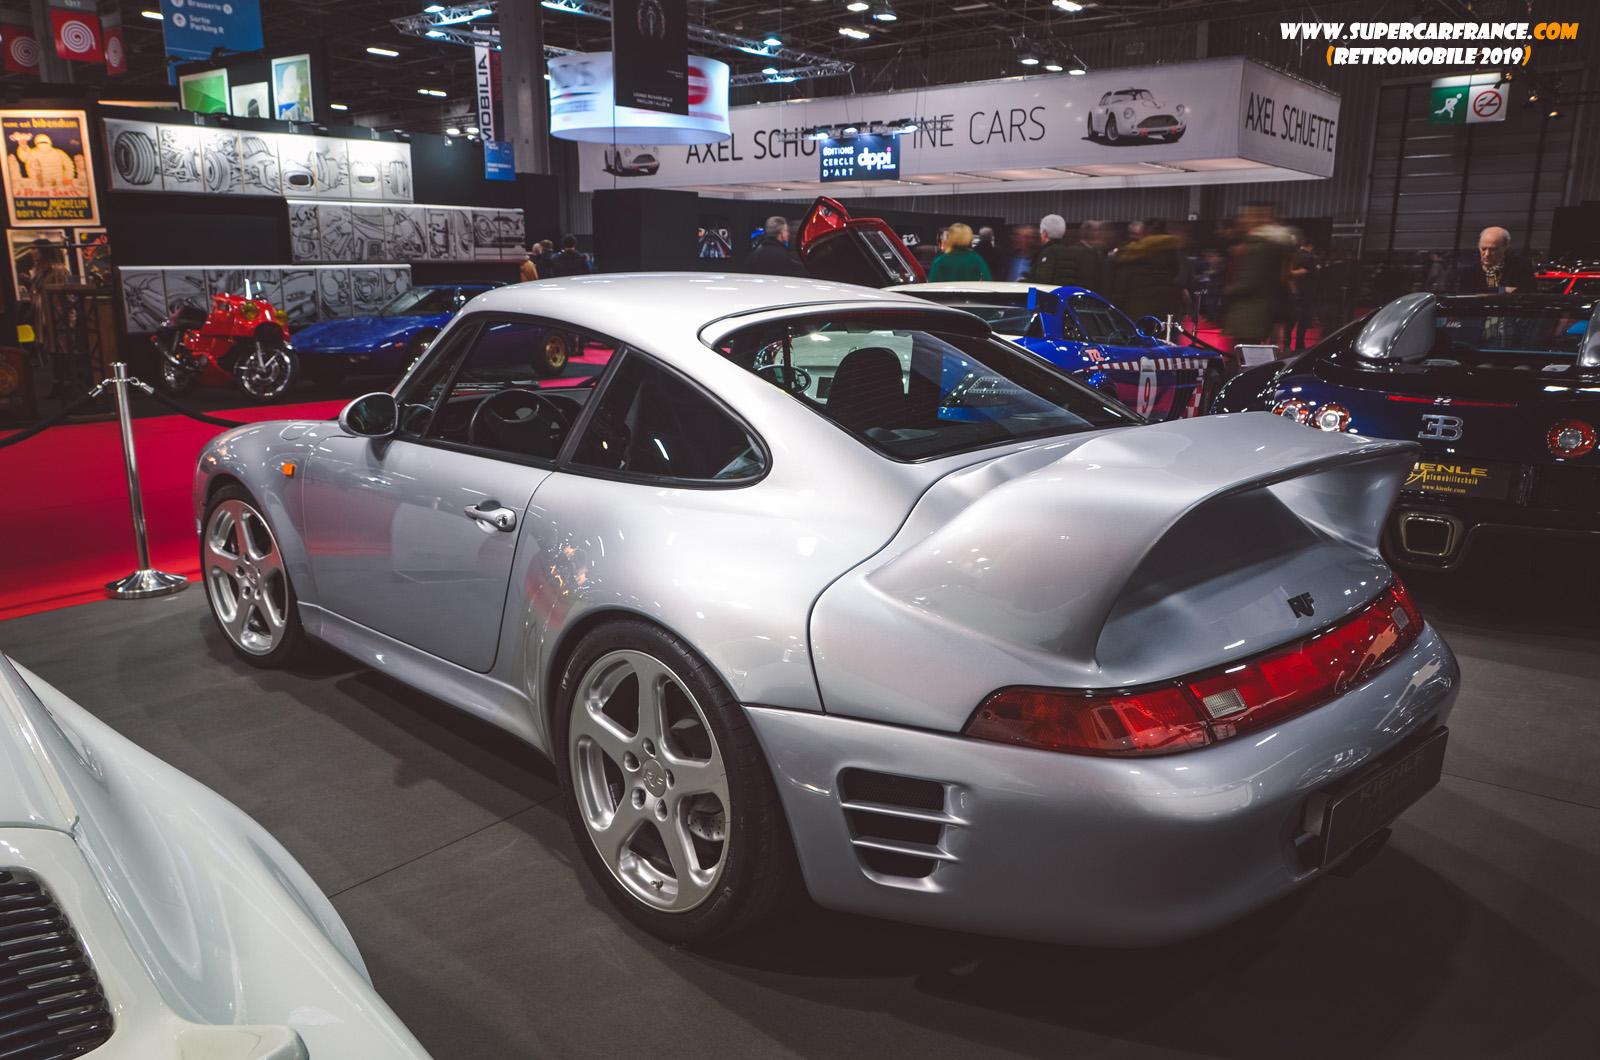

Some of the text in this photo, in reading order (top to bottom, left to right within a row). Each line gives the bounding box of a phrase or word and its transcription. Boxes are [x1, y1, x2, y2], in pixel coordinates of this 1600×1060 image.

[187, 0, 222, 11] Brasserie
[189, 14, 211, 24] Sortie
[190, 22, 218, 34] Parking
[478, 54, 492, 140] MOBILIA
[31, 117, 78, 128] bibendum
[1245, 91, 1336, 153] AXEL SCHUETTE
[686, 132, 744, 164] AXEL
[969, 106, 1046, 145] CARS
[823, 146, 892, 171] ÉDITIONS dppi
[823, 157, 854, 166] CERCLE
[822, 168, 854, 177] D'ART
[15, 200, 25, 208] LE
[49, 199, 88, 210] MICHELIN
[16, 210, 35, 218] BOIT
[1413, 462, 1488, 477] IENLE
[1421, 484, 1466, 493] www.kienle.com
[1359, 751, 1426, 803] KIENLE
